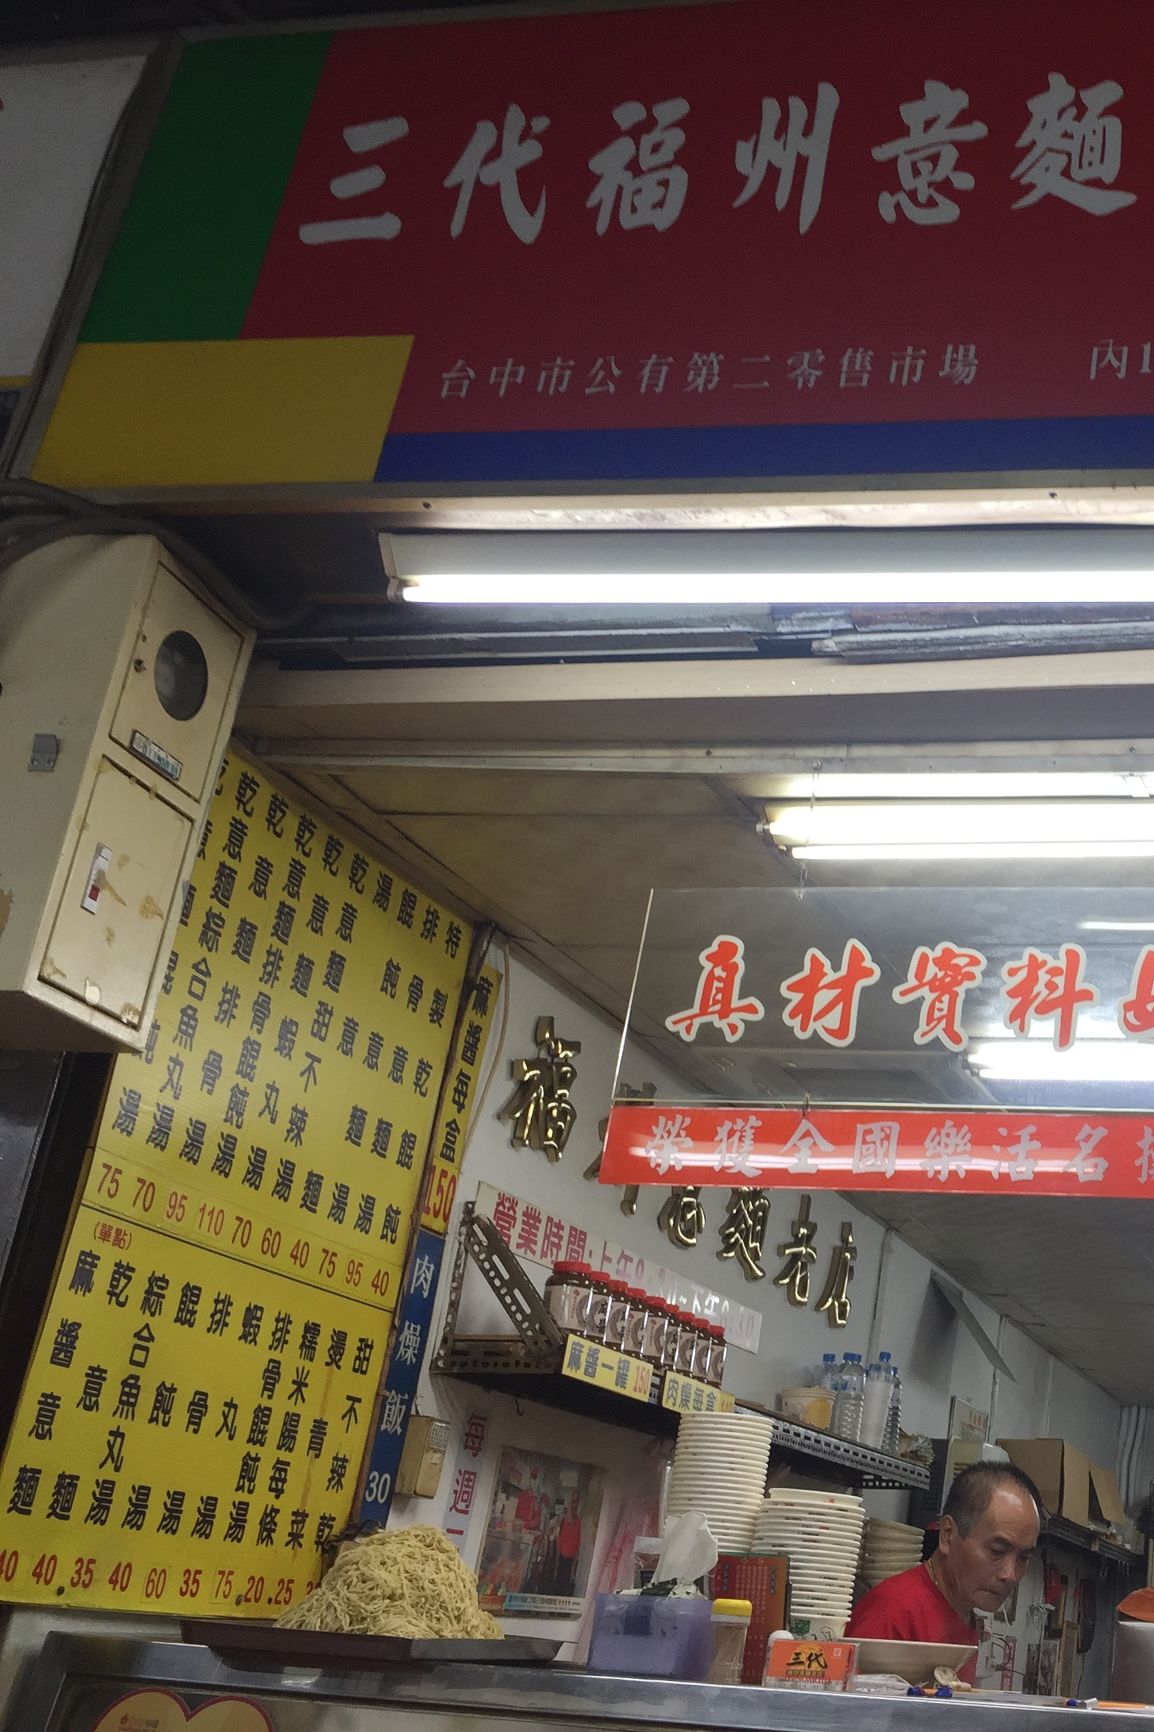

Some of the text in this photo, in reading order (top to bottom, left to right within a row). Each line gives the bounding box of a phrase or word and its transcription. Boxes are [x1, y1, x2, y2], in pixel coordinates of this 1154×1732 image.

[439, 343, 981, 399] 台中市公有第二零售市場
[146, 770, 260, 1152] 乾意麵綜合魚丸湯
[179, 793, 289, 1165] 乾意麵排骨湯
[211, 814, 317, 1178] 乾意麵排骨餛飩湯
[242, 835, 344, 1191] 乾意麵蝦丸湯
[271, 853, 369, 1203] 乾意麵甜不辣湯
[98, 1163, 390, 1297] 75 70 95 110 70 60 40 75 95 40
[7, 1249, 101, 1516] 麻醬意麵
[83, 1270, 170, 1526] 綜合魚丸湯
[156, 1291, 235, 1537] 排骨湯
[223, 1312, 294, 1545] 排骨餛飩湯
[364, 1254, 436, 1504] 肉燥飯 30
[31, 1554, 58, 1586] 40
[70, 1557, 96, 1590] 35
[108, 1562, 132, 1592] 40
[144, 1568, 168, 1599] 60
[179, 1569, 202, 1598] 35
[214, 1570, 234, 1600] 75
[243, 1576, 265, 1603] 20
[273, 1578, 295, 1606] 25
